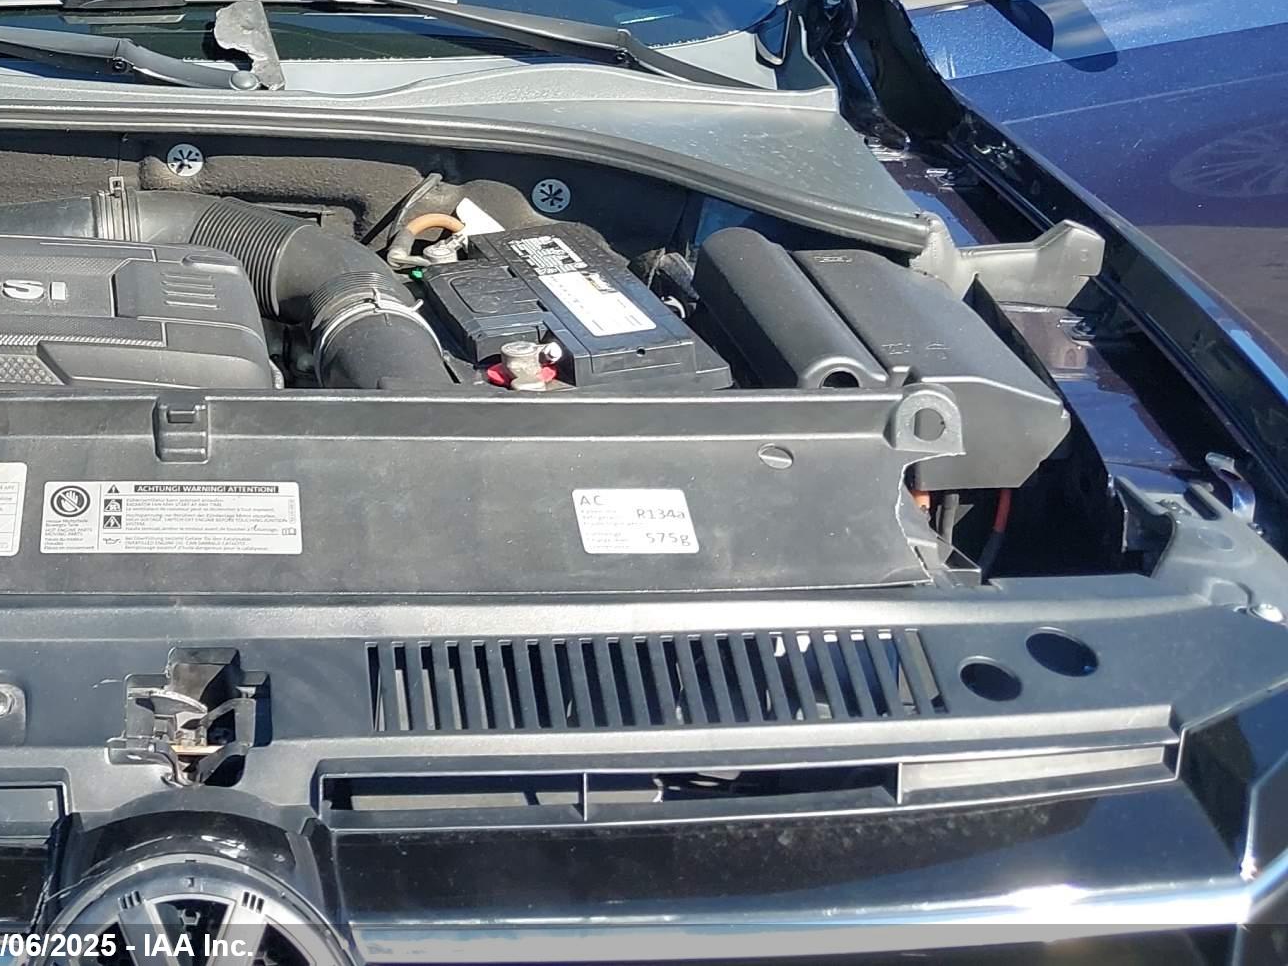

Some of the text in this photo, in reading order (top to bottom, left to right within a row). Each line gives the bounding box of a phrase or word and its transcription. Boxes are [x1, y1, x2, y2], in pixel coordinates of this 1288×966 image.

[183, 485, 226, 493] WARNING!
[580, 495, 604, 506] AC
[636, 508, 686, 520] R134a
[645, 532, 692, 547] 575g
